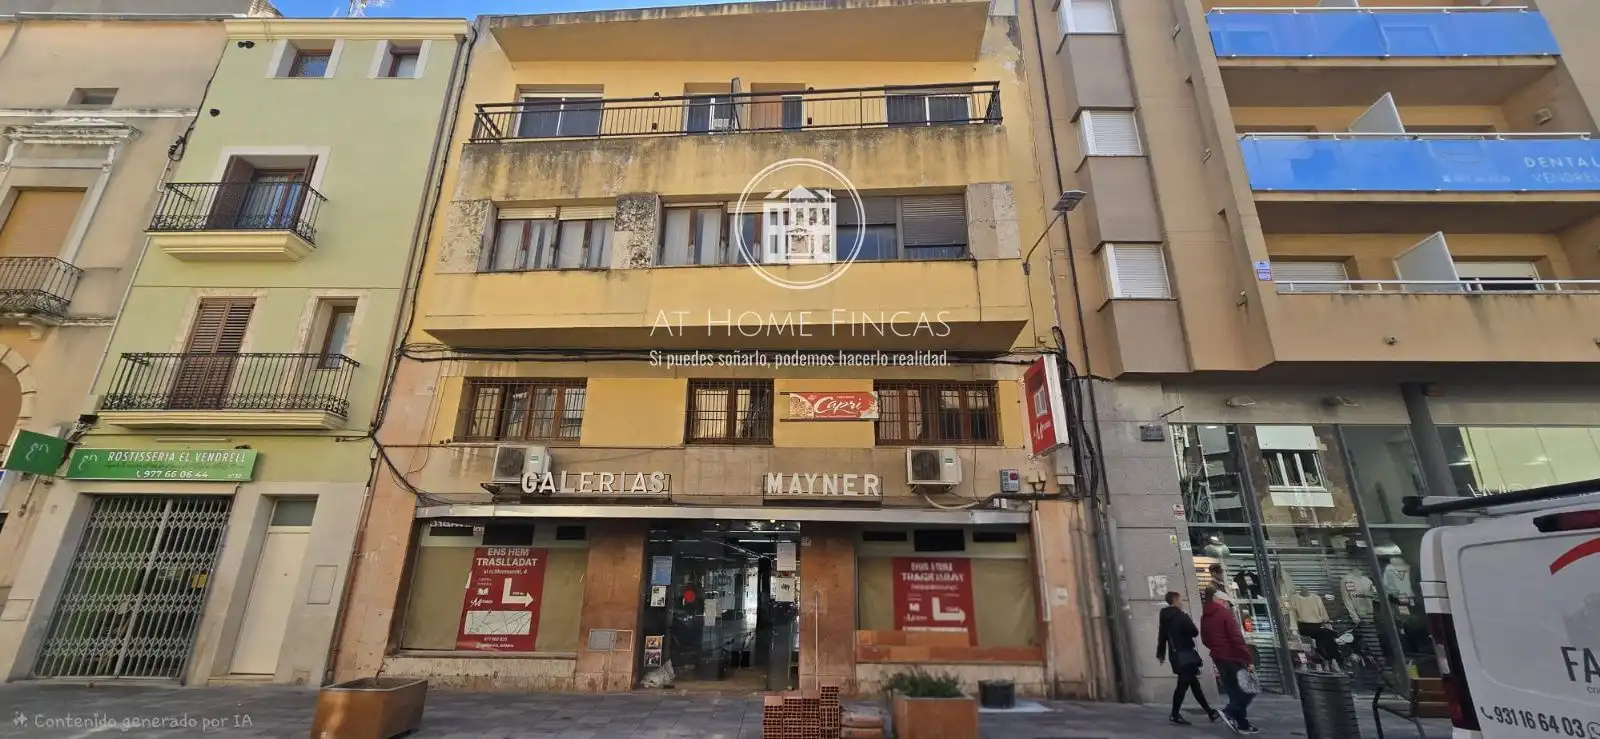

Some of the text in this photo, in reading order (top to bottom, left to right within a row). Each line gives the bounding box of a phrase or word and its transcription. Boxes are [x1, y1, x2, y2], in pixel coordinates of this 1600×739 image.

[1524, 157, 1600, 168] DENTAL
[813, 396, 863, 415] Capri
[107, 451, 247, 463] ROSTISSERIA EL VENDRELL
[521, 470, 880, 496] GALERIAS MAYNER
[487, 548, 530, 556] ENS HEM
[476, 558, 539, 567] TRASLLADAT
[1494, 706, 1585, 738] 931 16 64 03
